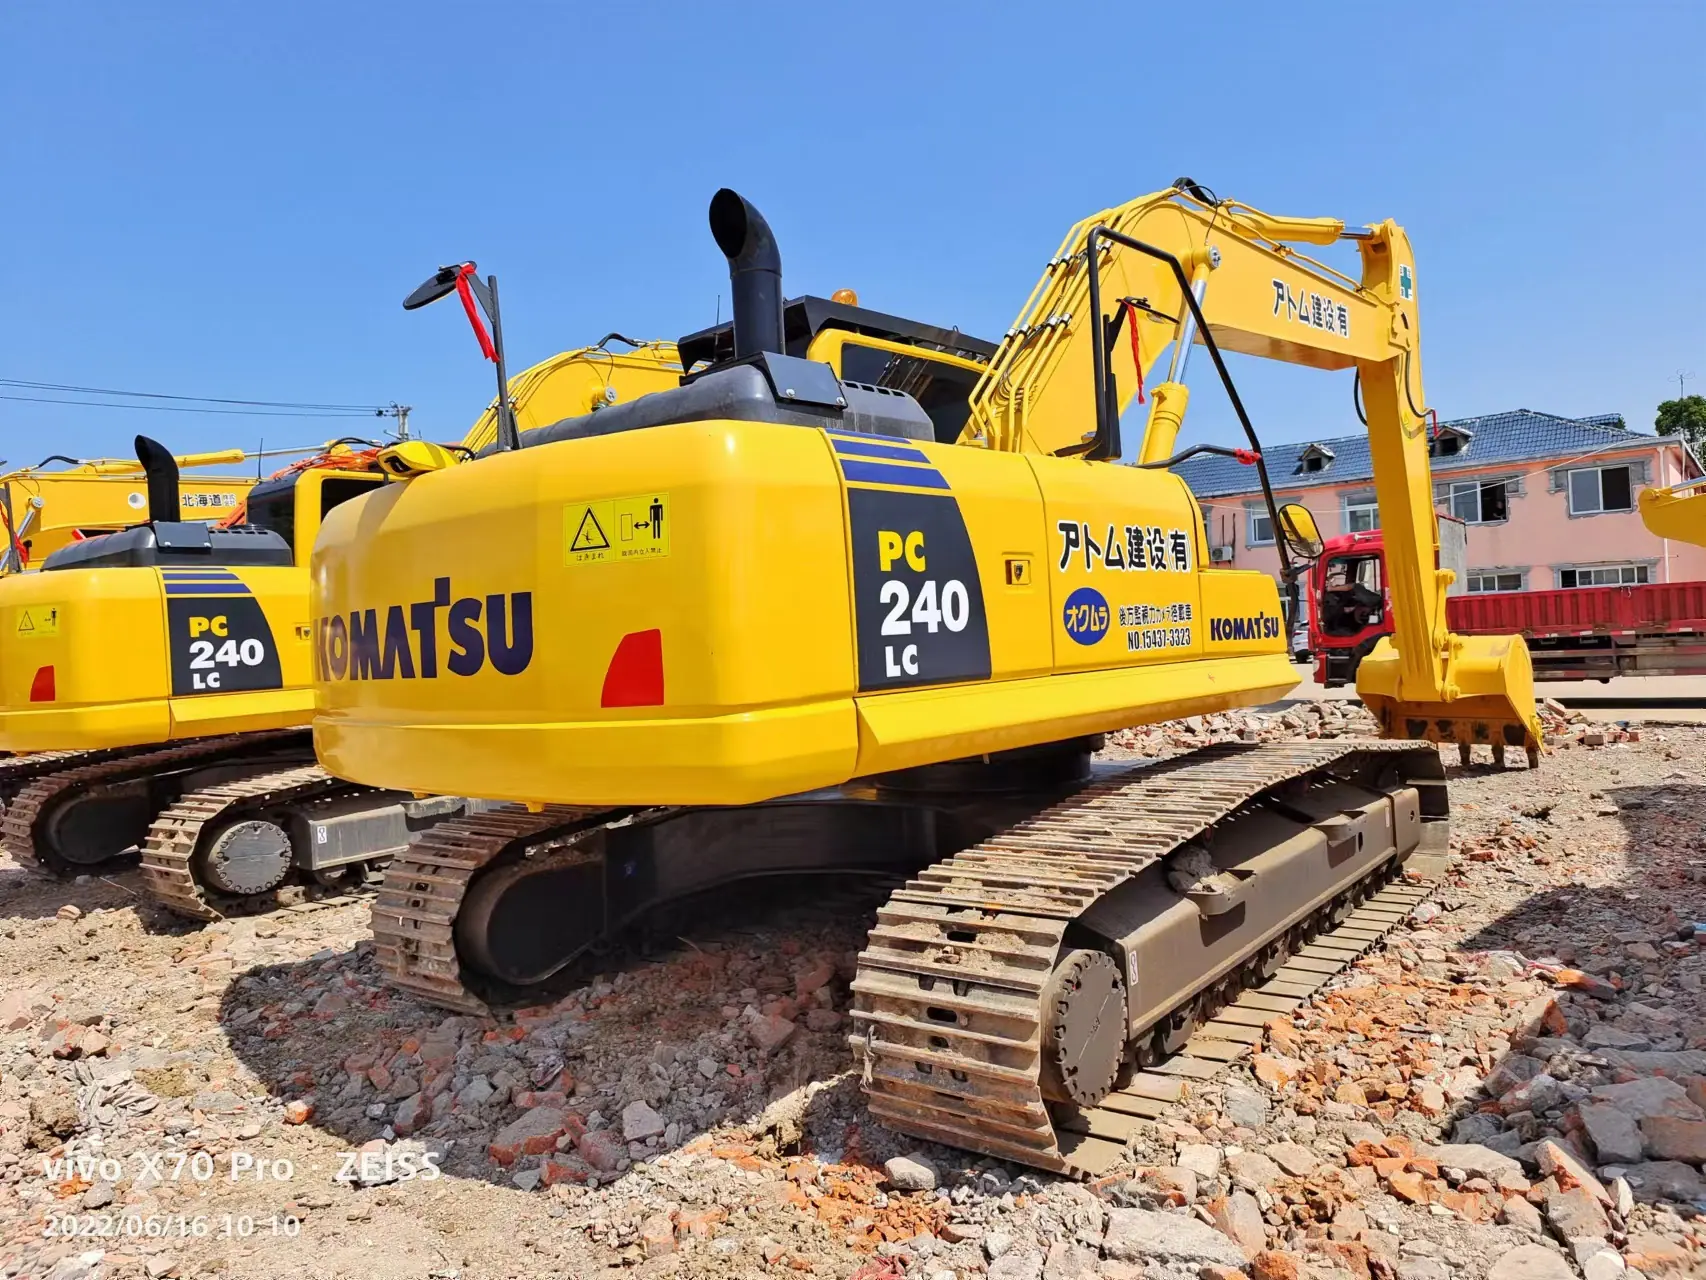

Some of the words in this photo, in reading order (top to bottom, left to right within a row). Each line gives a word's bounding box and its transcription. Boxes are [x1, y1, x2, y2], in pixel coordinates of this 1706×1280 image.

[182, 494, 222, 507] 北海道
[878, 530, 926, 572] PC
[880, 579, 969, 635] 240
[1066, 604, 1108, 632] オクムラ
[189, 615, 228, 638] PC
[314, 576, 533, 681] KOMATSU
[1210, 611, 1279, 641] KOMATSU
[189, 638, 264, 669] 240
[885, 644, 919, 678] LC
[193, 672, 220, 689] LC
